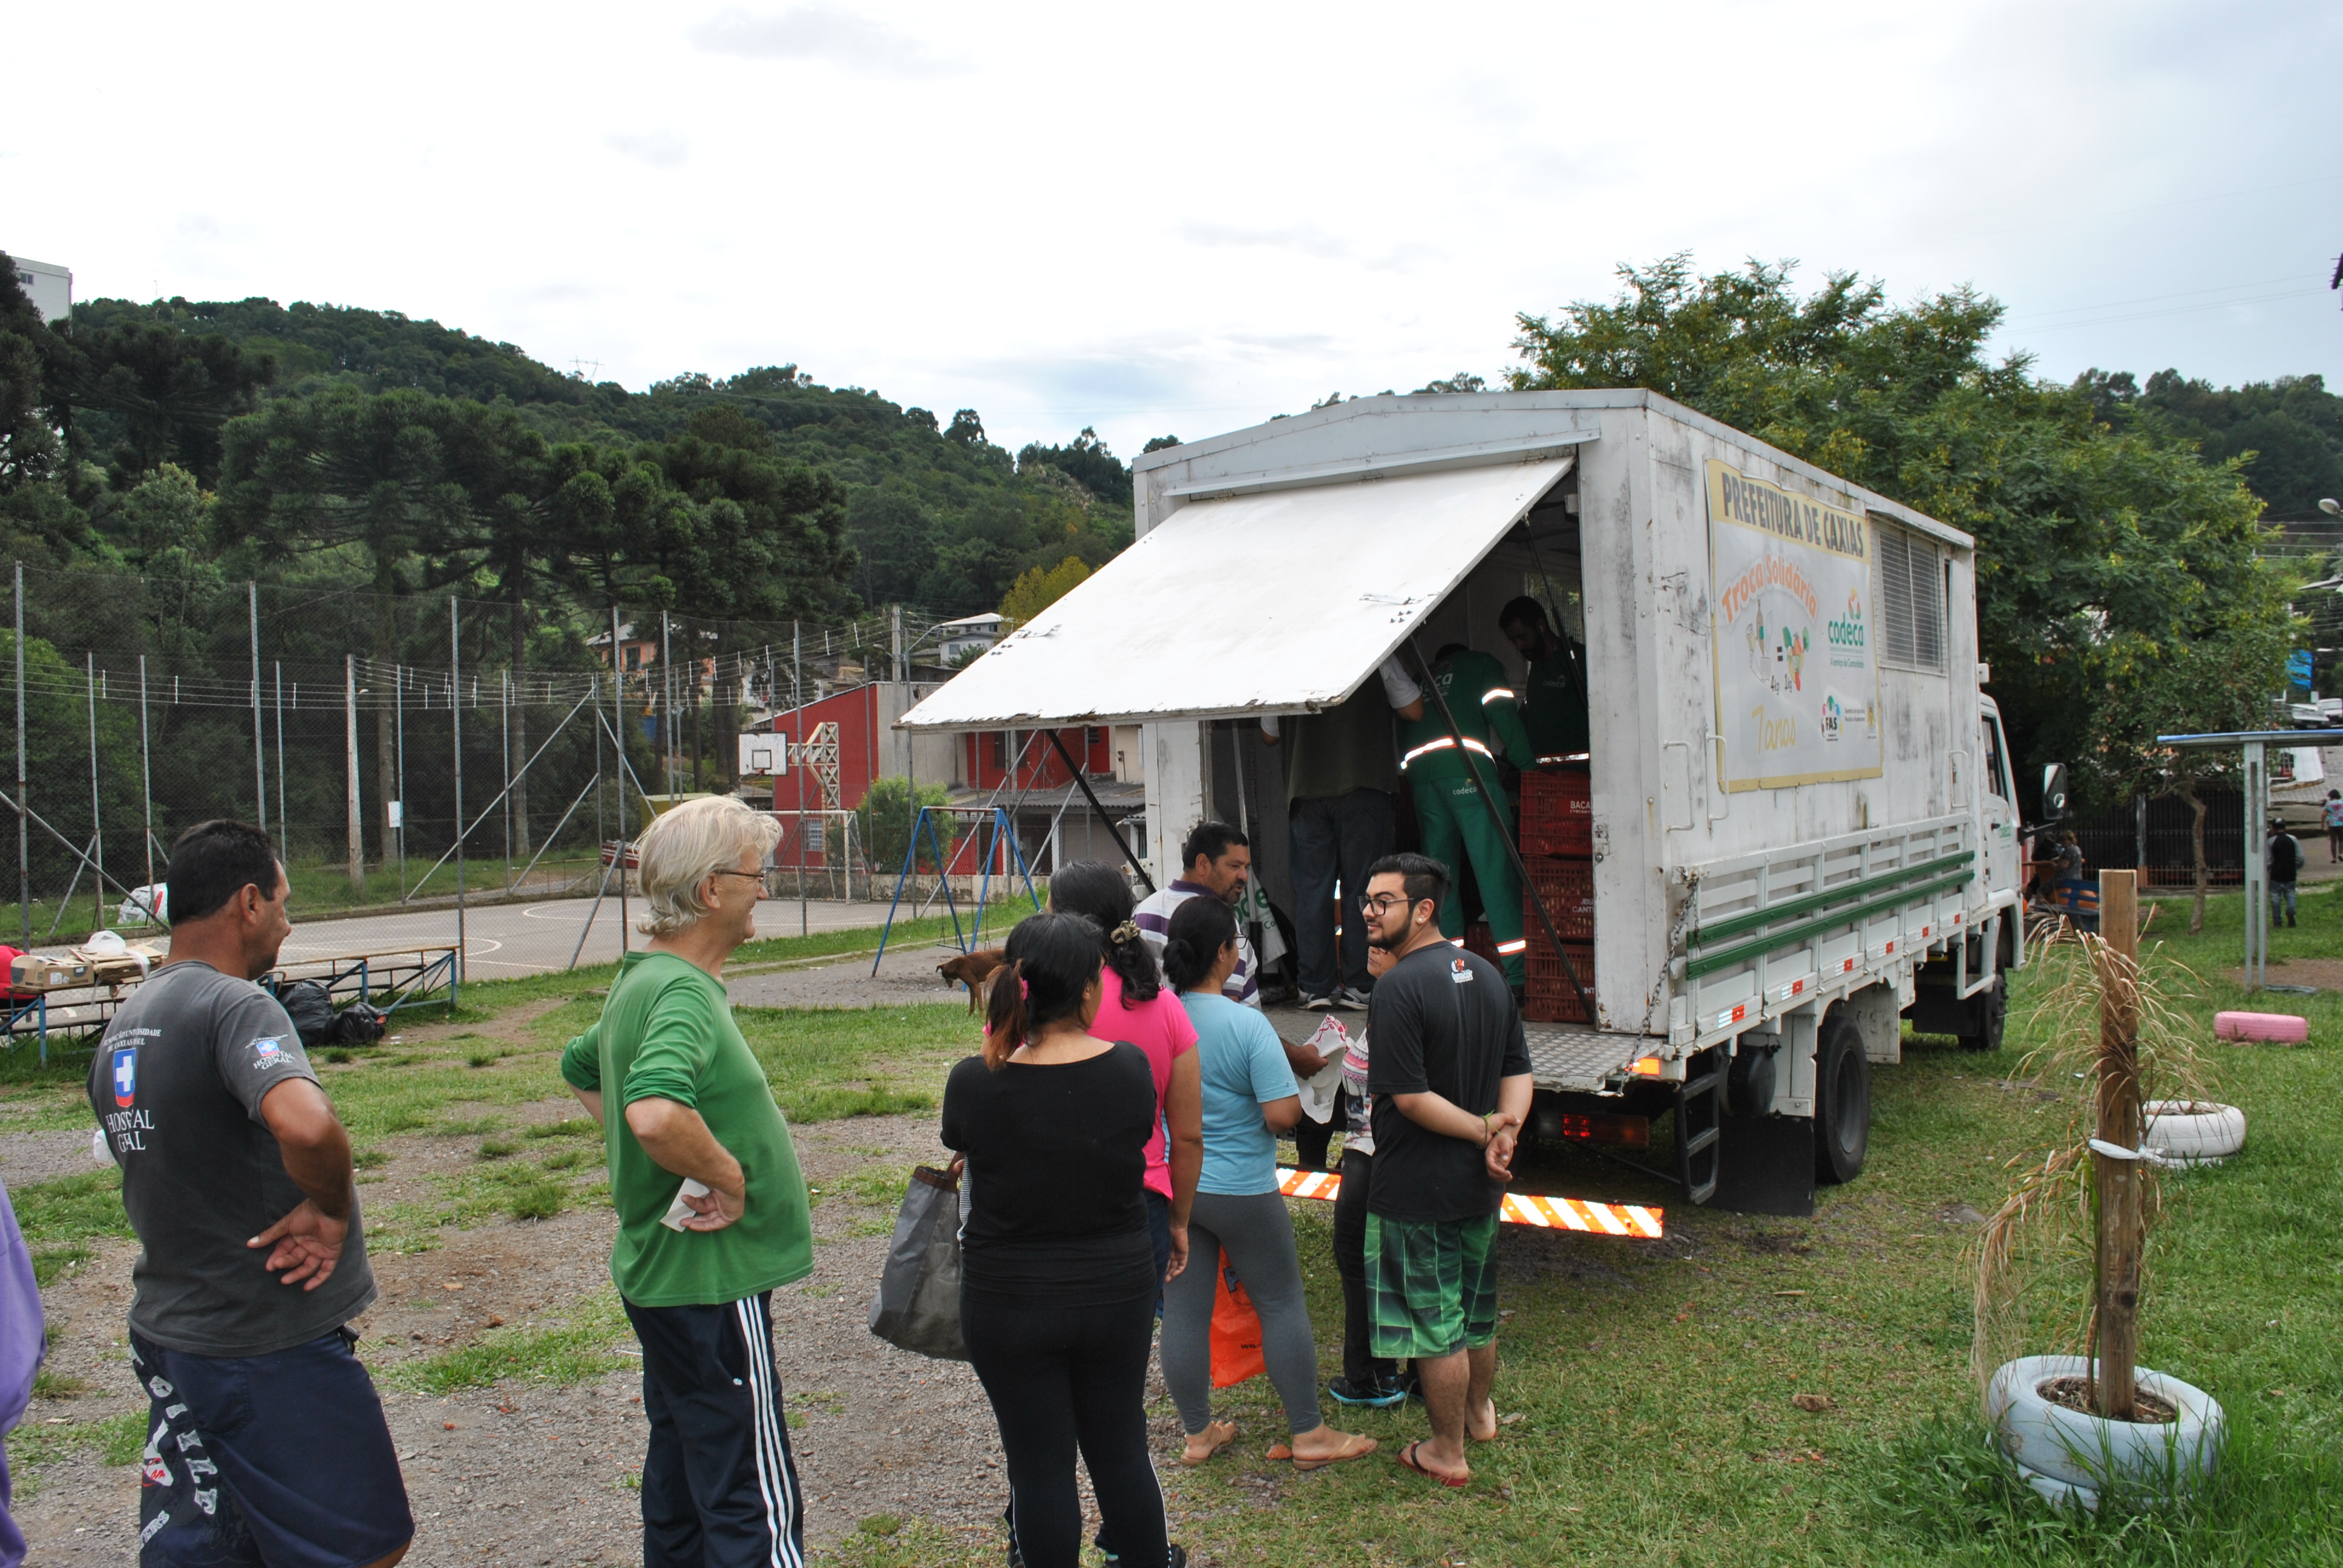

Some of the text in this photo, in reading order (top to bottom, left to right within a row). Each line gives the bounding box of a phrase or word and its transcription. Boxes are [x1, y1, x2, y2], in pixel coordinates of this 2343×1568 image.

[1722, 472, 1864, 558] PREFEITURA DE CAXIAS
[1722, 554, 1817, 624] Troca Solidária
[1828, 612, 1864, 646] codeca
[1826, 717, 1837, 730] FAS
[1453, 786, 1477, 795] codeca
[105, 1109, 156, 1134] HOSPAL
[117, 1131, 146, 1153] GAL
